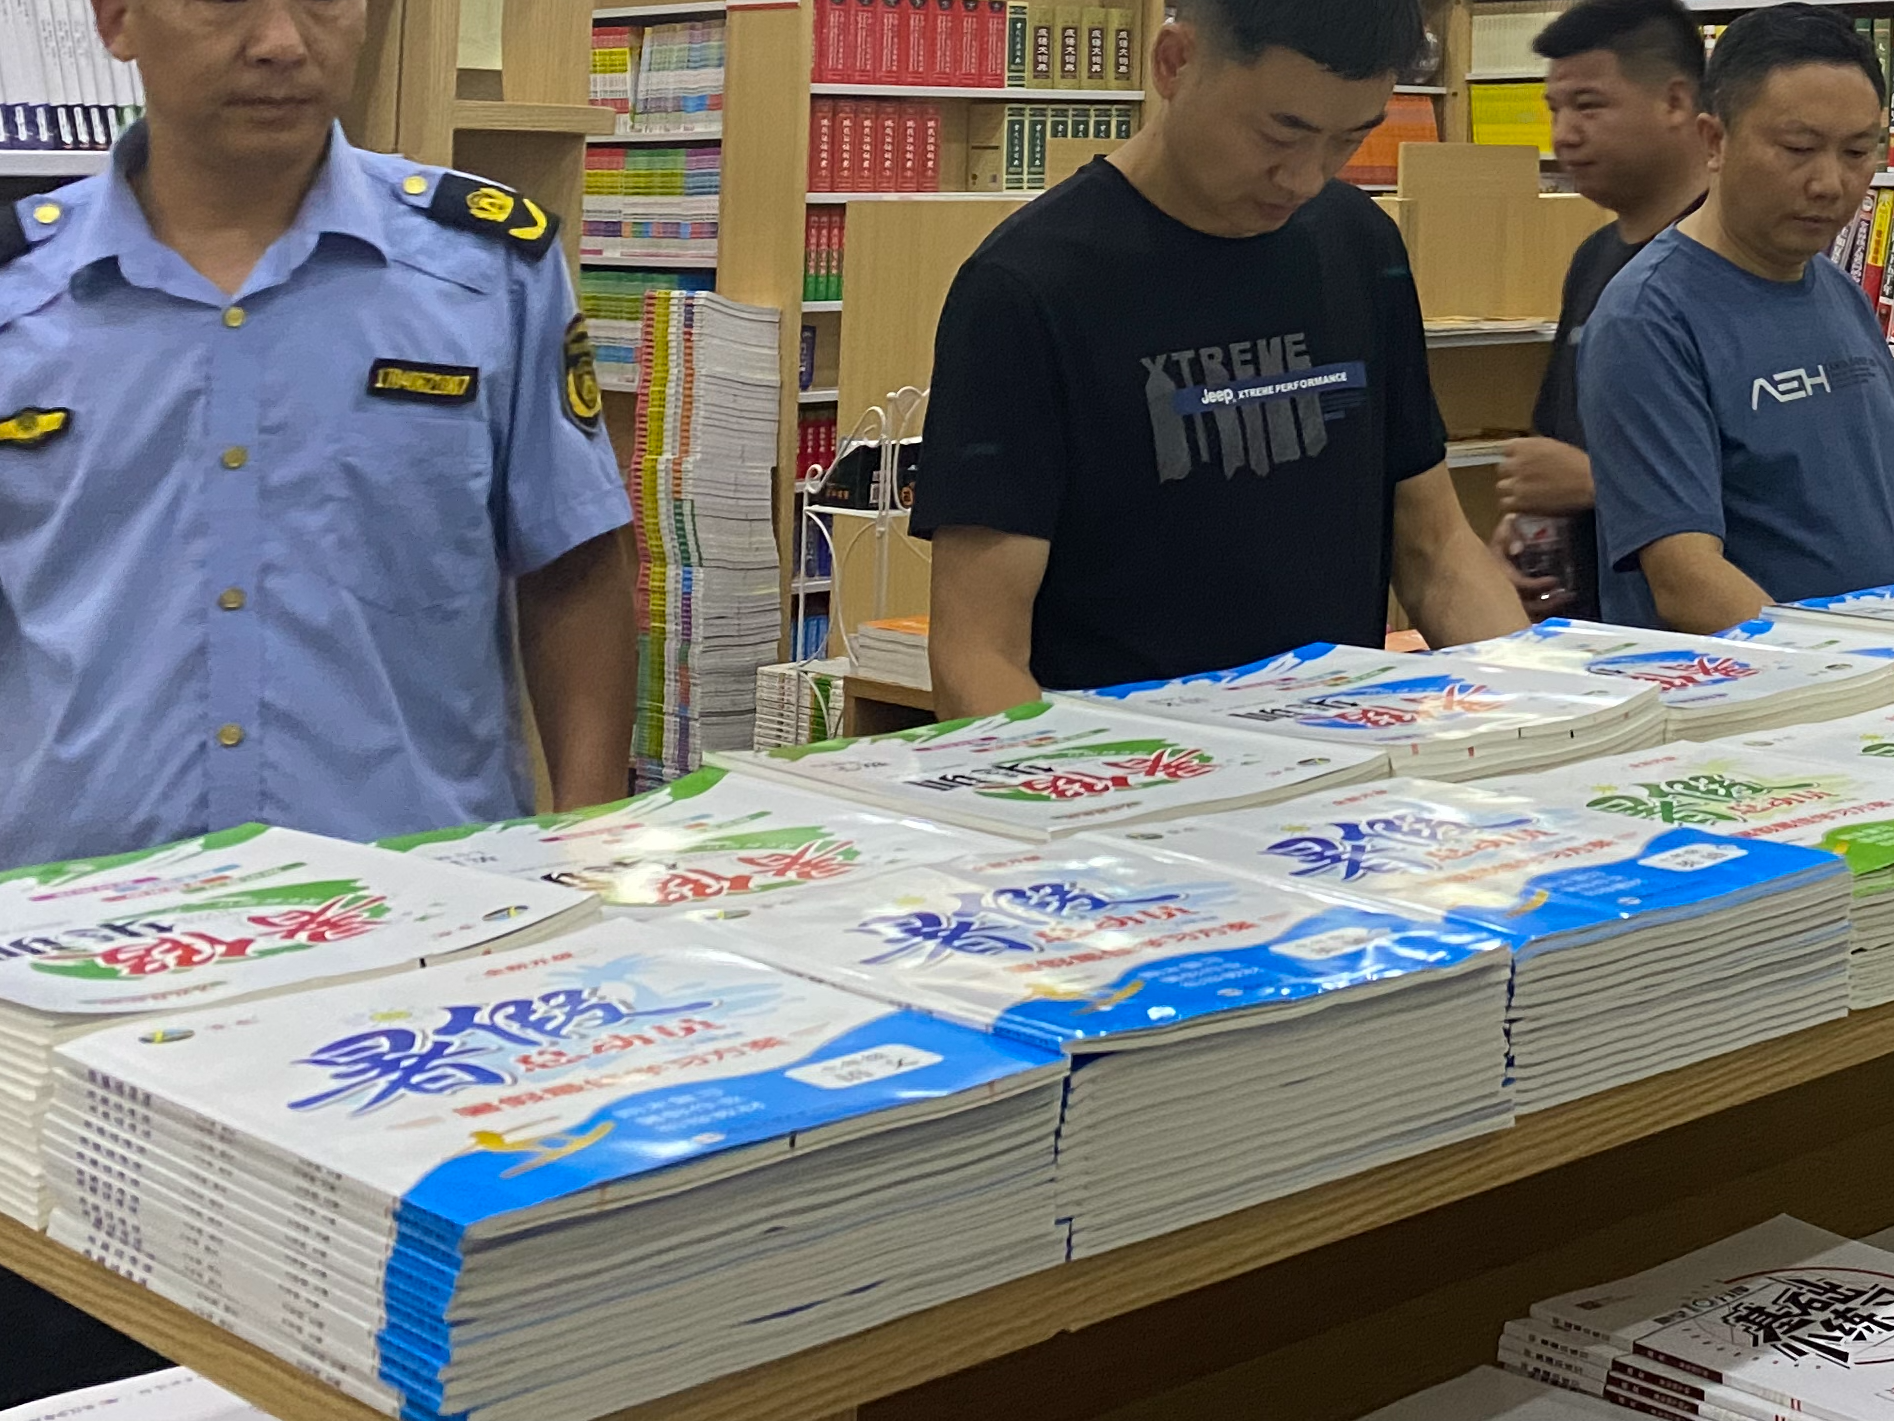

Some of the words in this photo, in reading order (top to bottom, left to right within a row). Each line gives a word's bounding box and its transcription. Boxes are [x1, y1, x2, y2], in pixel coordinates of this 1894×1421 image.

[1036, 28, 1049, 72] 成语大词典
[1064, 28, 1076, 72] 成语大词典
[1091, 29, 1102, 73] 成语大词典
[1118, 31, 1129, 73] 成语大词典
[1201, 388, 1233, 405] Jeep
[1238, 386, 1275, 400] XTREME
[1275, 371, 1347, 394] PERFORMANCE
[1018, 747, 1222, 800] 暑假
[1586, 774, 1820, 826] 暑假
[1728, 788, 1837, 817] 总动员
[1266, 814, 1541, 881] 暑假
[99, 894, 389, 977] 暑假
[844, 881, 1189, 970] 暑假
[1034, 906, 1196, 943] 总动员
[287, 986, 722, 1117] 暑假
[515, 1018, 724, 1073] 总动员
[1722, 1275, 1875, 1346] 基础
